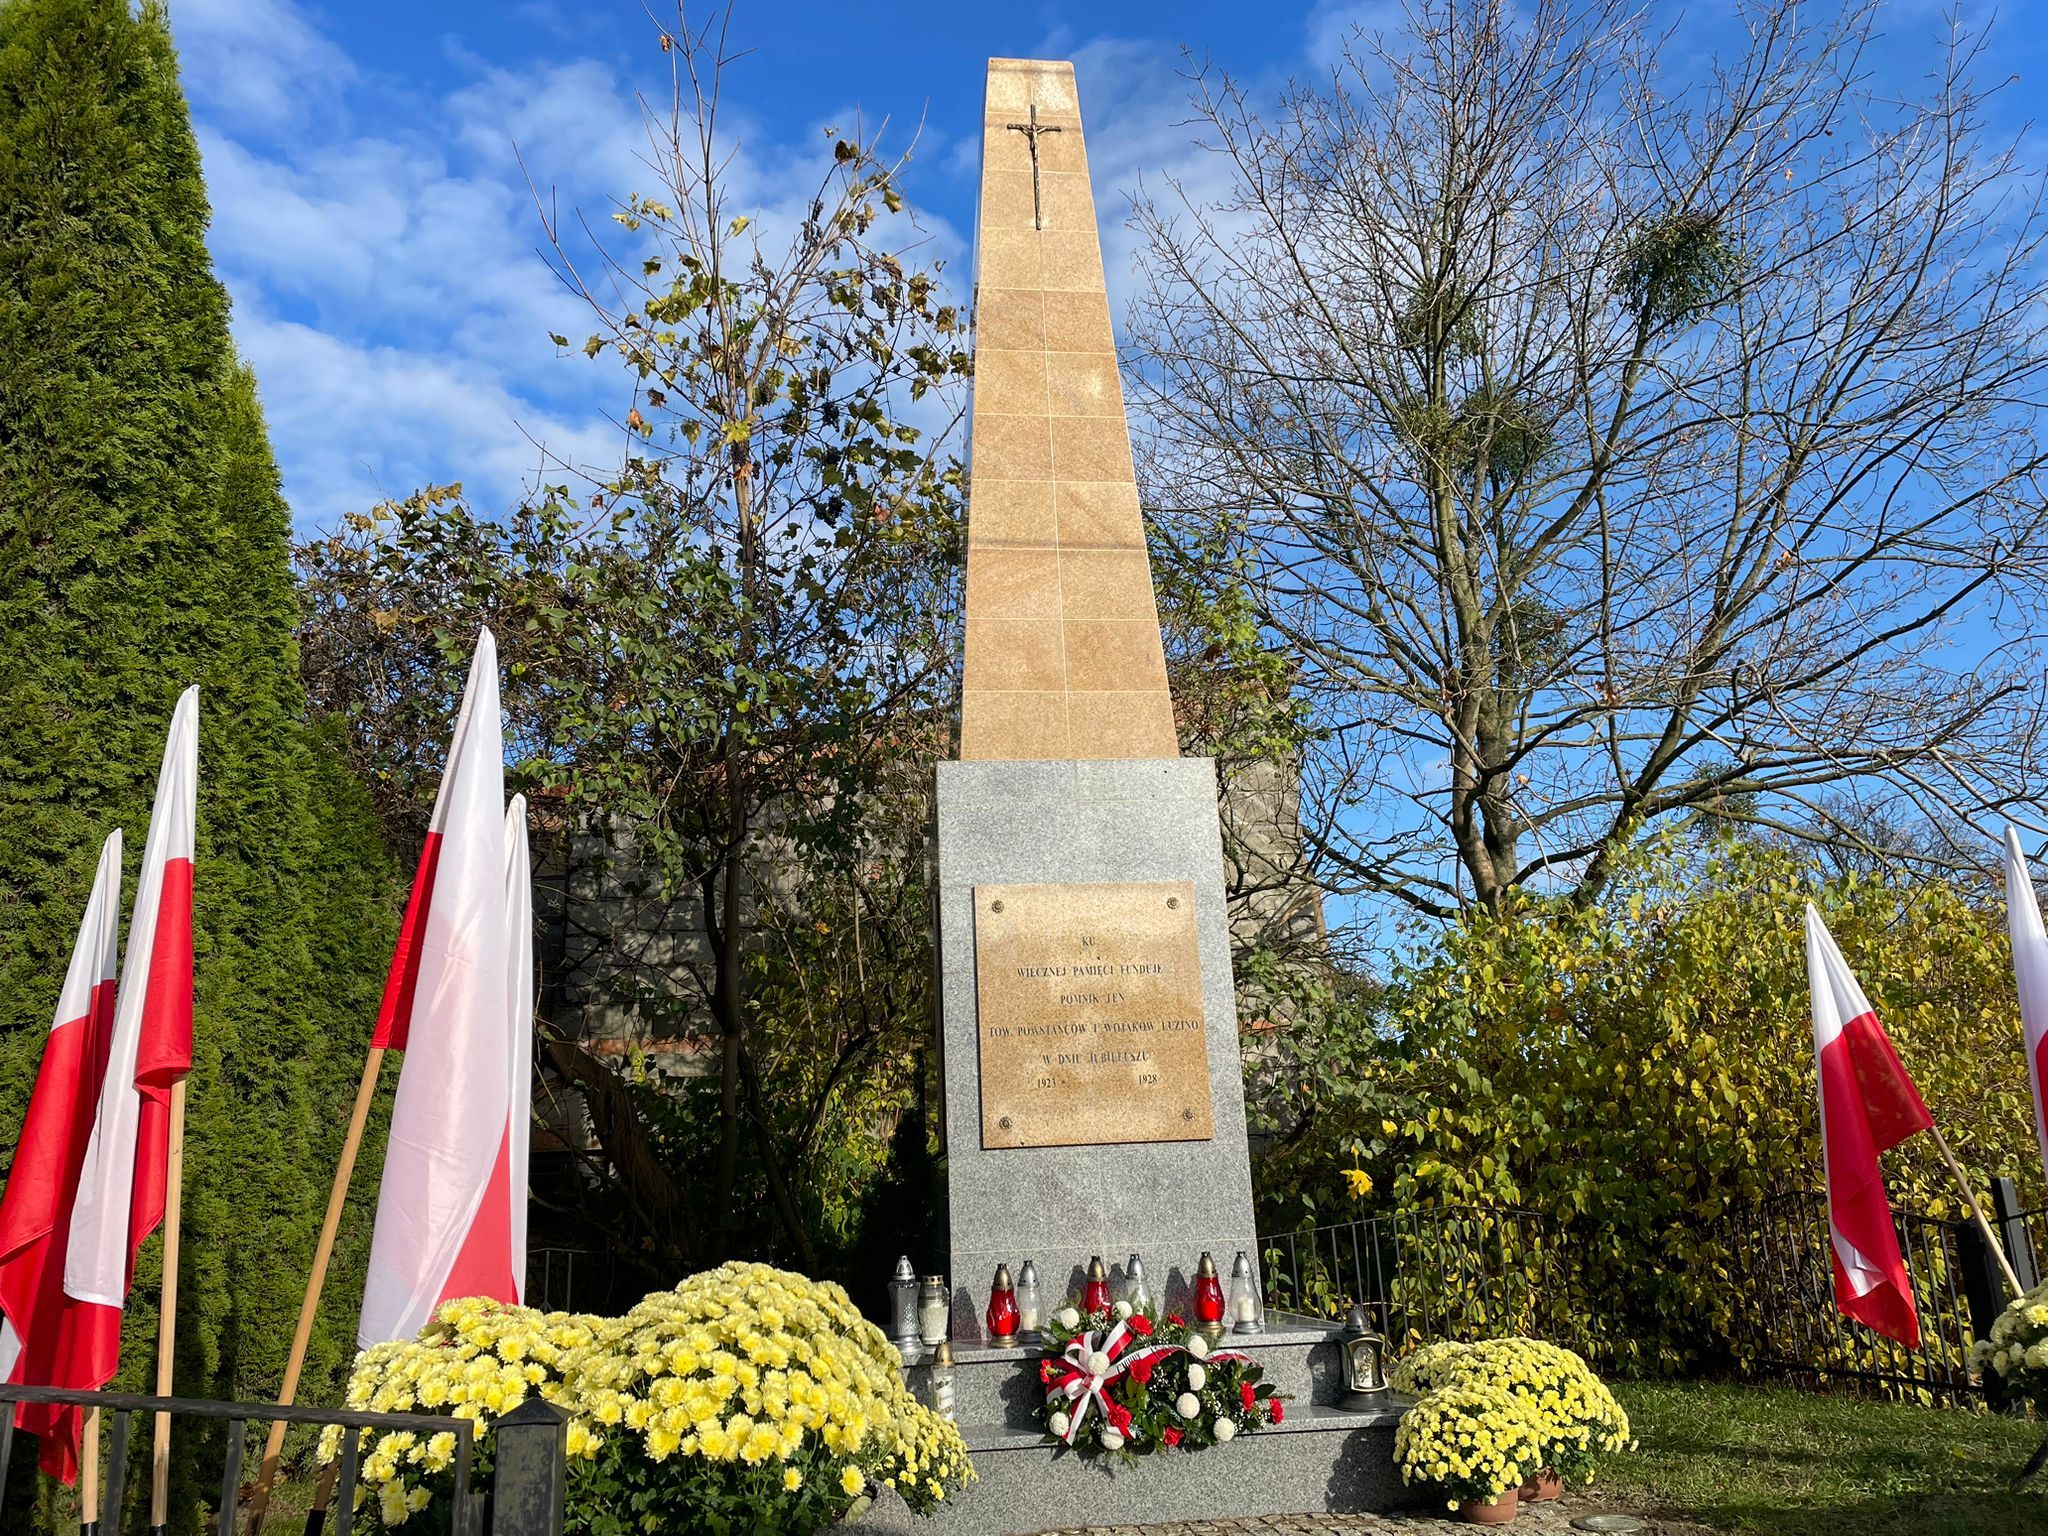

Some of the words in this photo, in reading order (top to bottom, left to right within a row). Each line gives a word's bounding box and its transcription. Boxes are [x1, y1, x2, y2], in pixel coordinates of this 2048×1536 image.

[1082, 936, 1095, 947] KU
[1017, 966, 1067, 978] WIECZNEJ
[1120, 964, 1163, 975] FUNDUJE
[1060, 993, 1100, 1005] POMNIK
[1106, 992, 1125, 1004] TEN
[1161, 1020, 1199, 1031] LUZINO
[1042, 1054, 1051, 1065] W
[1058, 1053, 1081, 1065] DNIU
[1037, 1077, 1056, 1089] 1923
[1138, 1074, 1158, 1085] 1928
